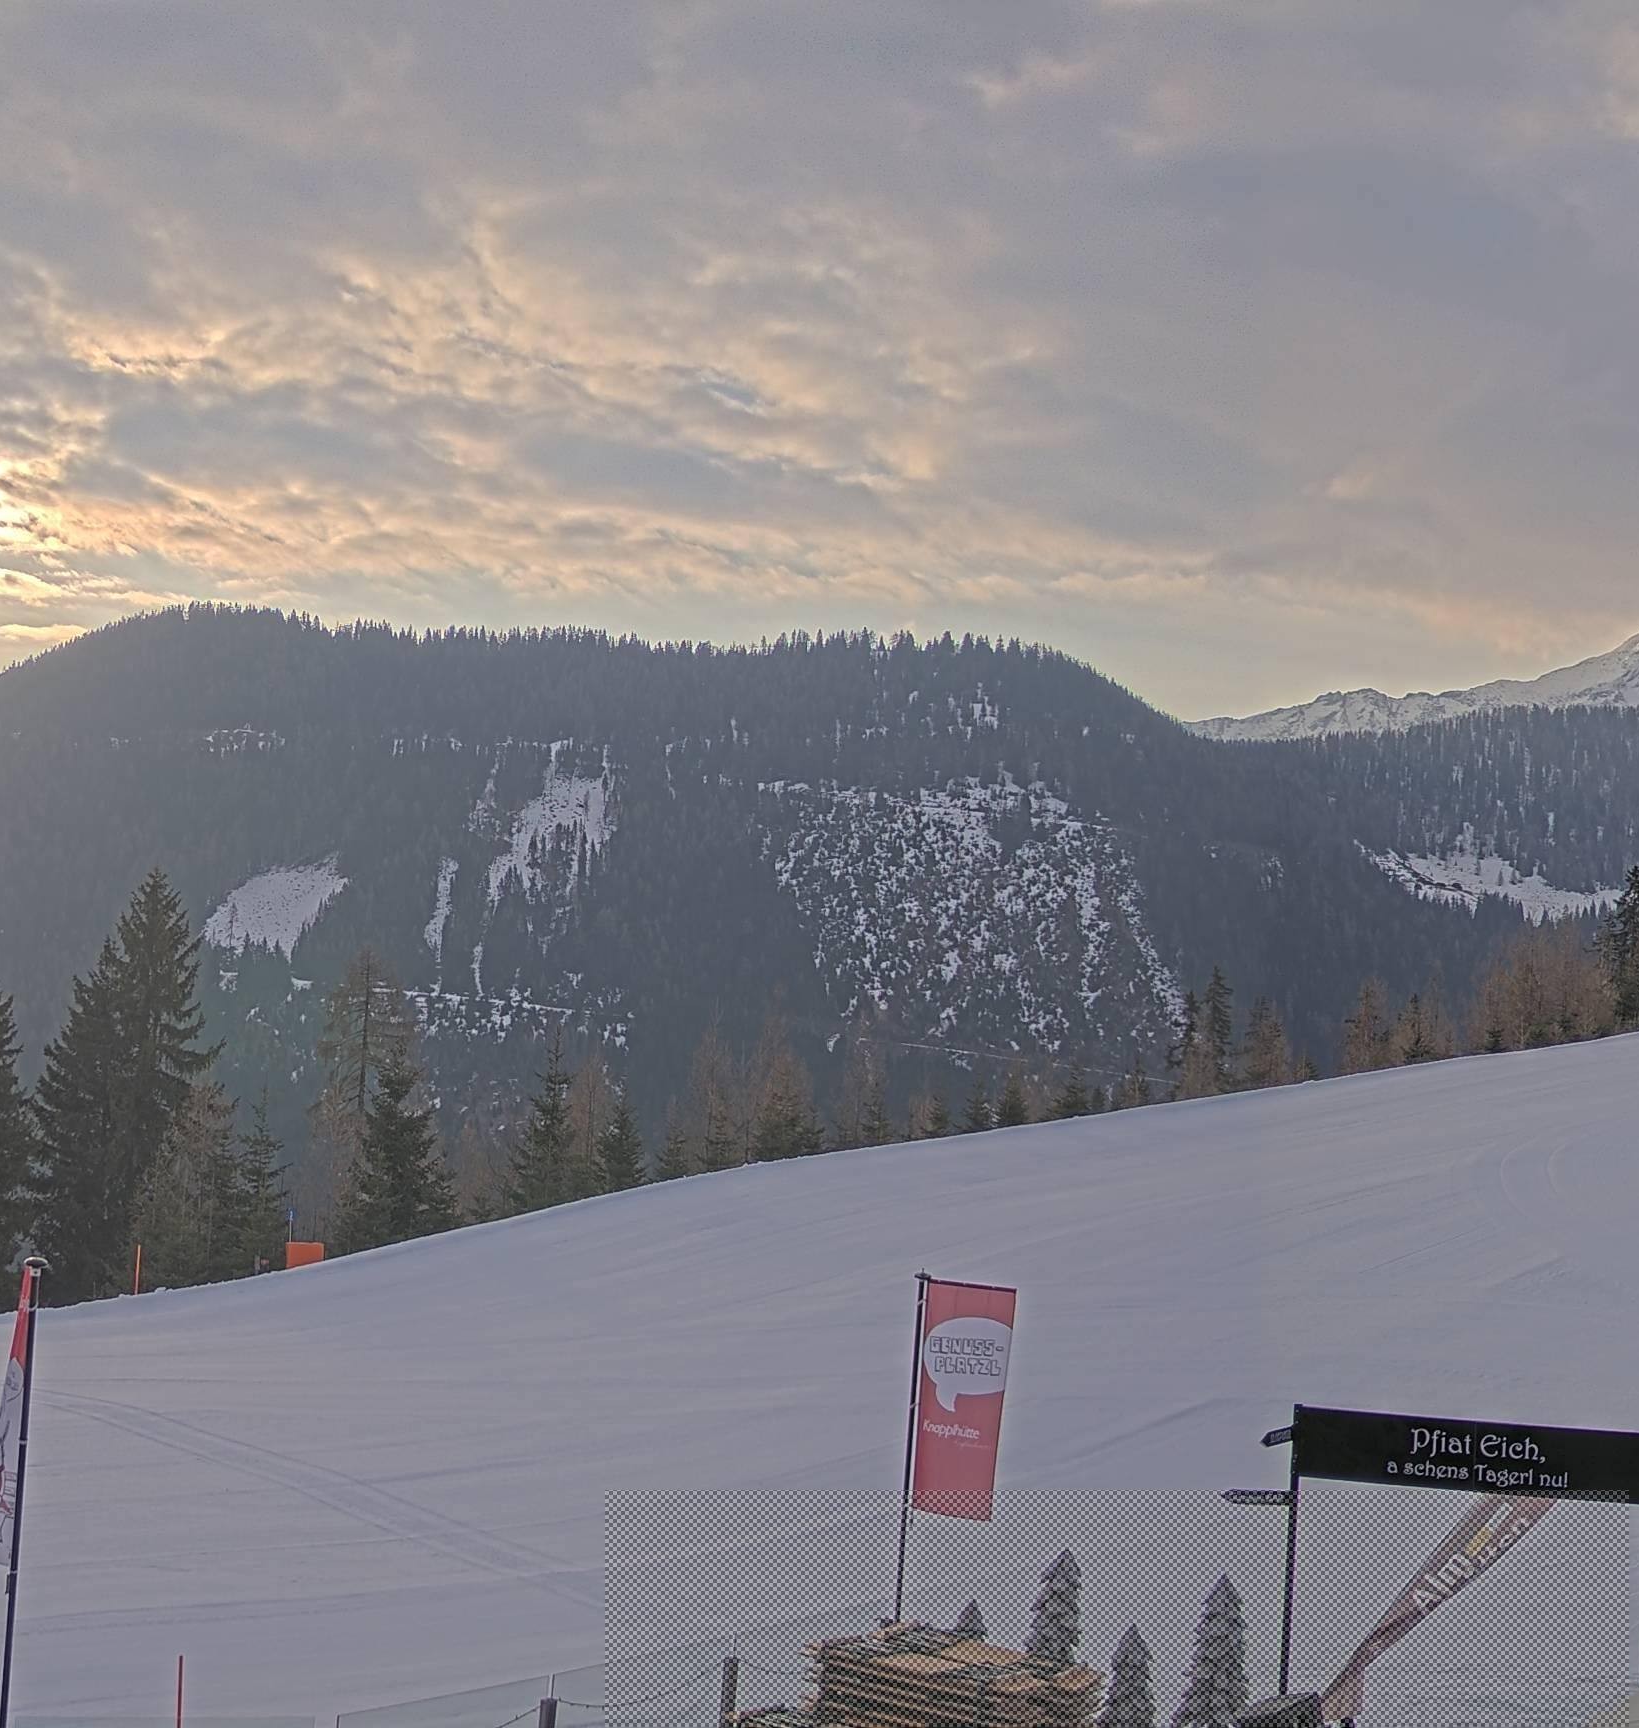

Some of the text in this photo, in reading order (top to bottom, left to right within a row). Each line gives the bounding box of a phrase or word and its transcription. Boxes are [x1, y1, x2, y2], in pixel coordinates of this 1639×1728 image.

[930, 1335, 1005, 1357] GENUSS-
[935, 1356, 1002, 1377] PLATZL
[923, 1419, 980, 1440] Knapplhütte
[1410, 1427, 1547, 1464] Pfiat Eich,
[1387, 1460, 1569, 1488] a schens Tagerl nu!
